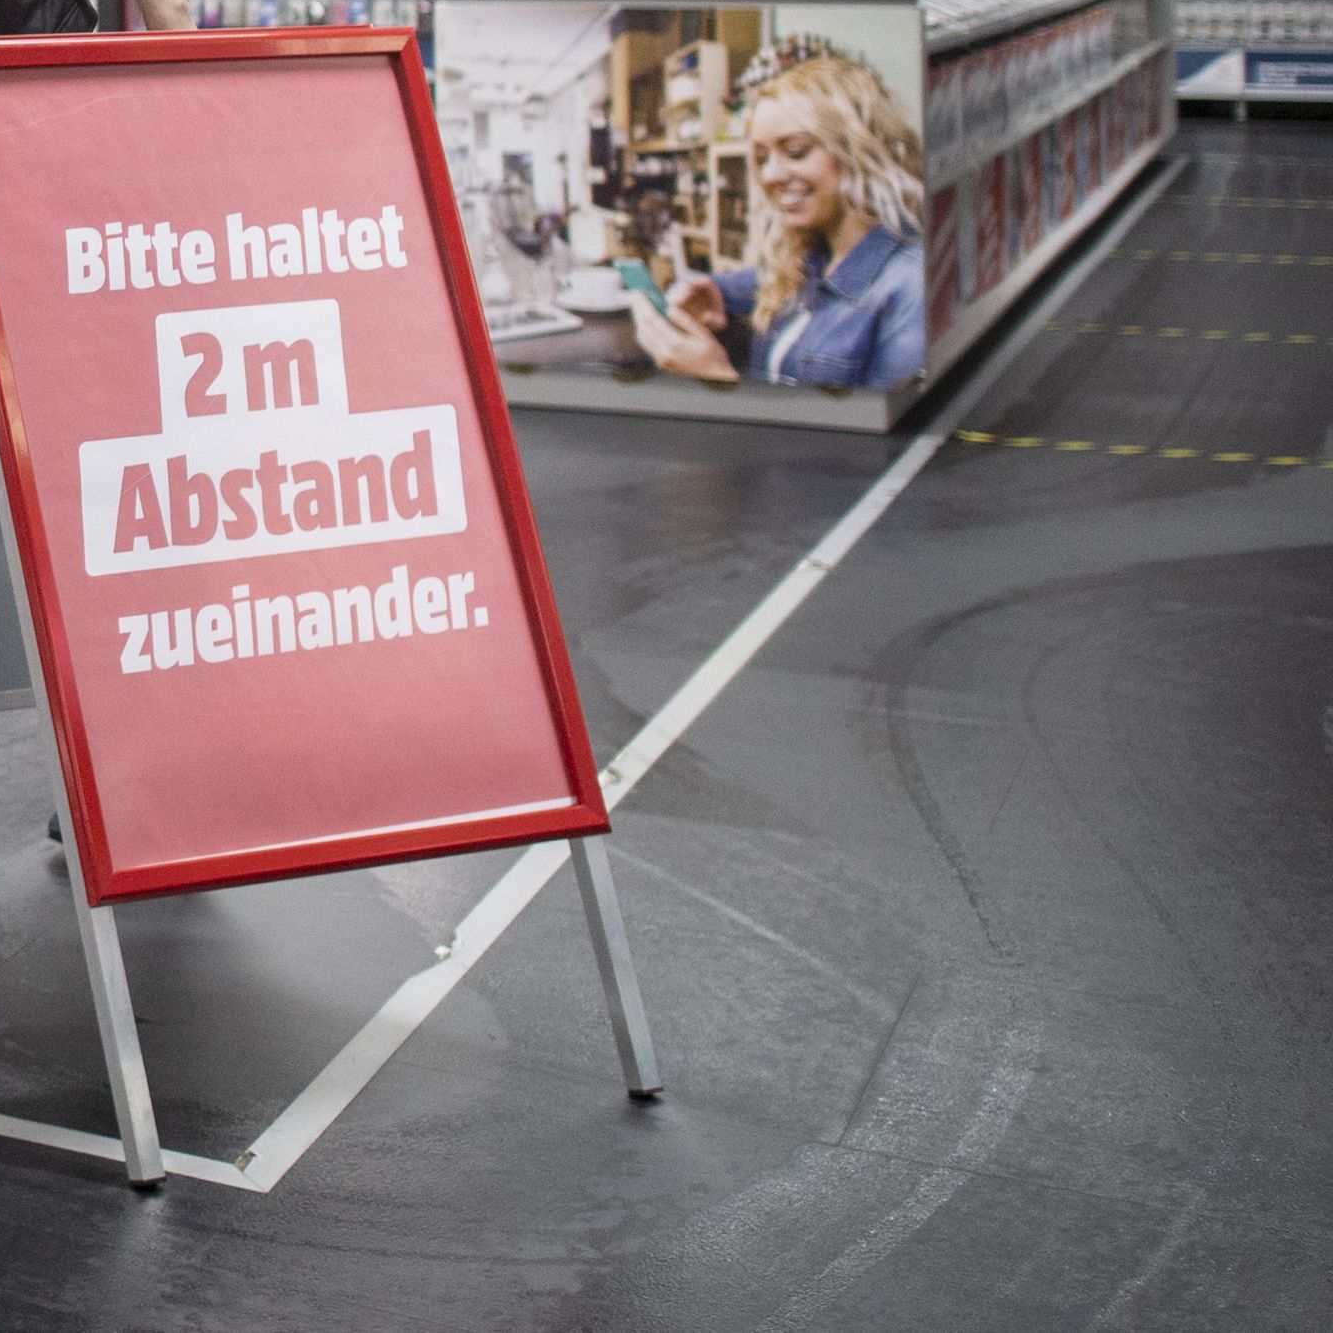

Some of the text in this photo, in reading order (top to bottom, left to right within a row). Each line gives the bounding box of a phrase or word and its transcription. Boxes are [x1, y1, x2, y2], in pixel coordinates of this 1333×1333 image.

[65, 203, 408, 295] Bitte haltet
[179, 330, 320, 419] 2 m
[113, 429, 439, 554] Abstand
[118, 563, 490, 675] zueinander.
